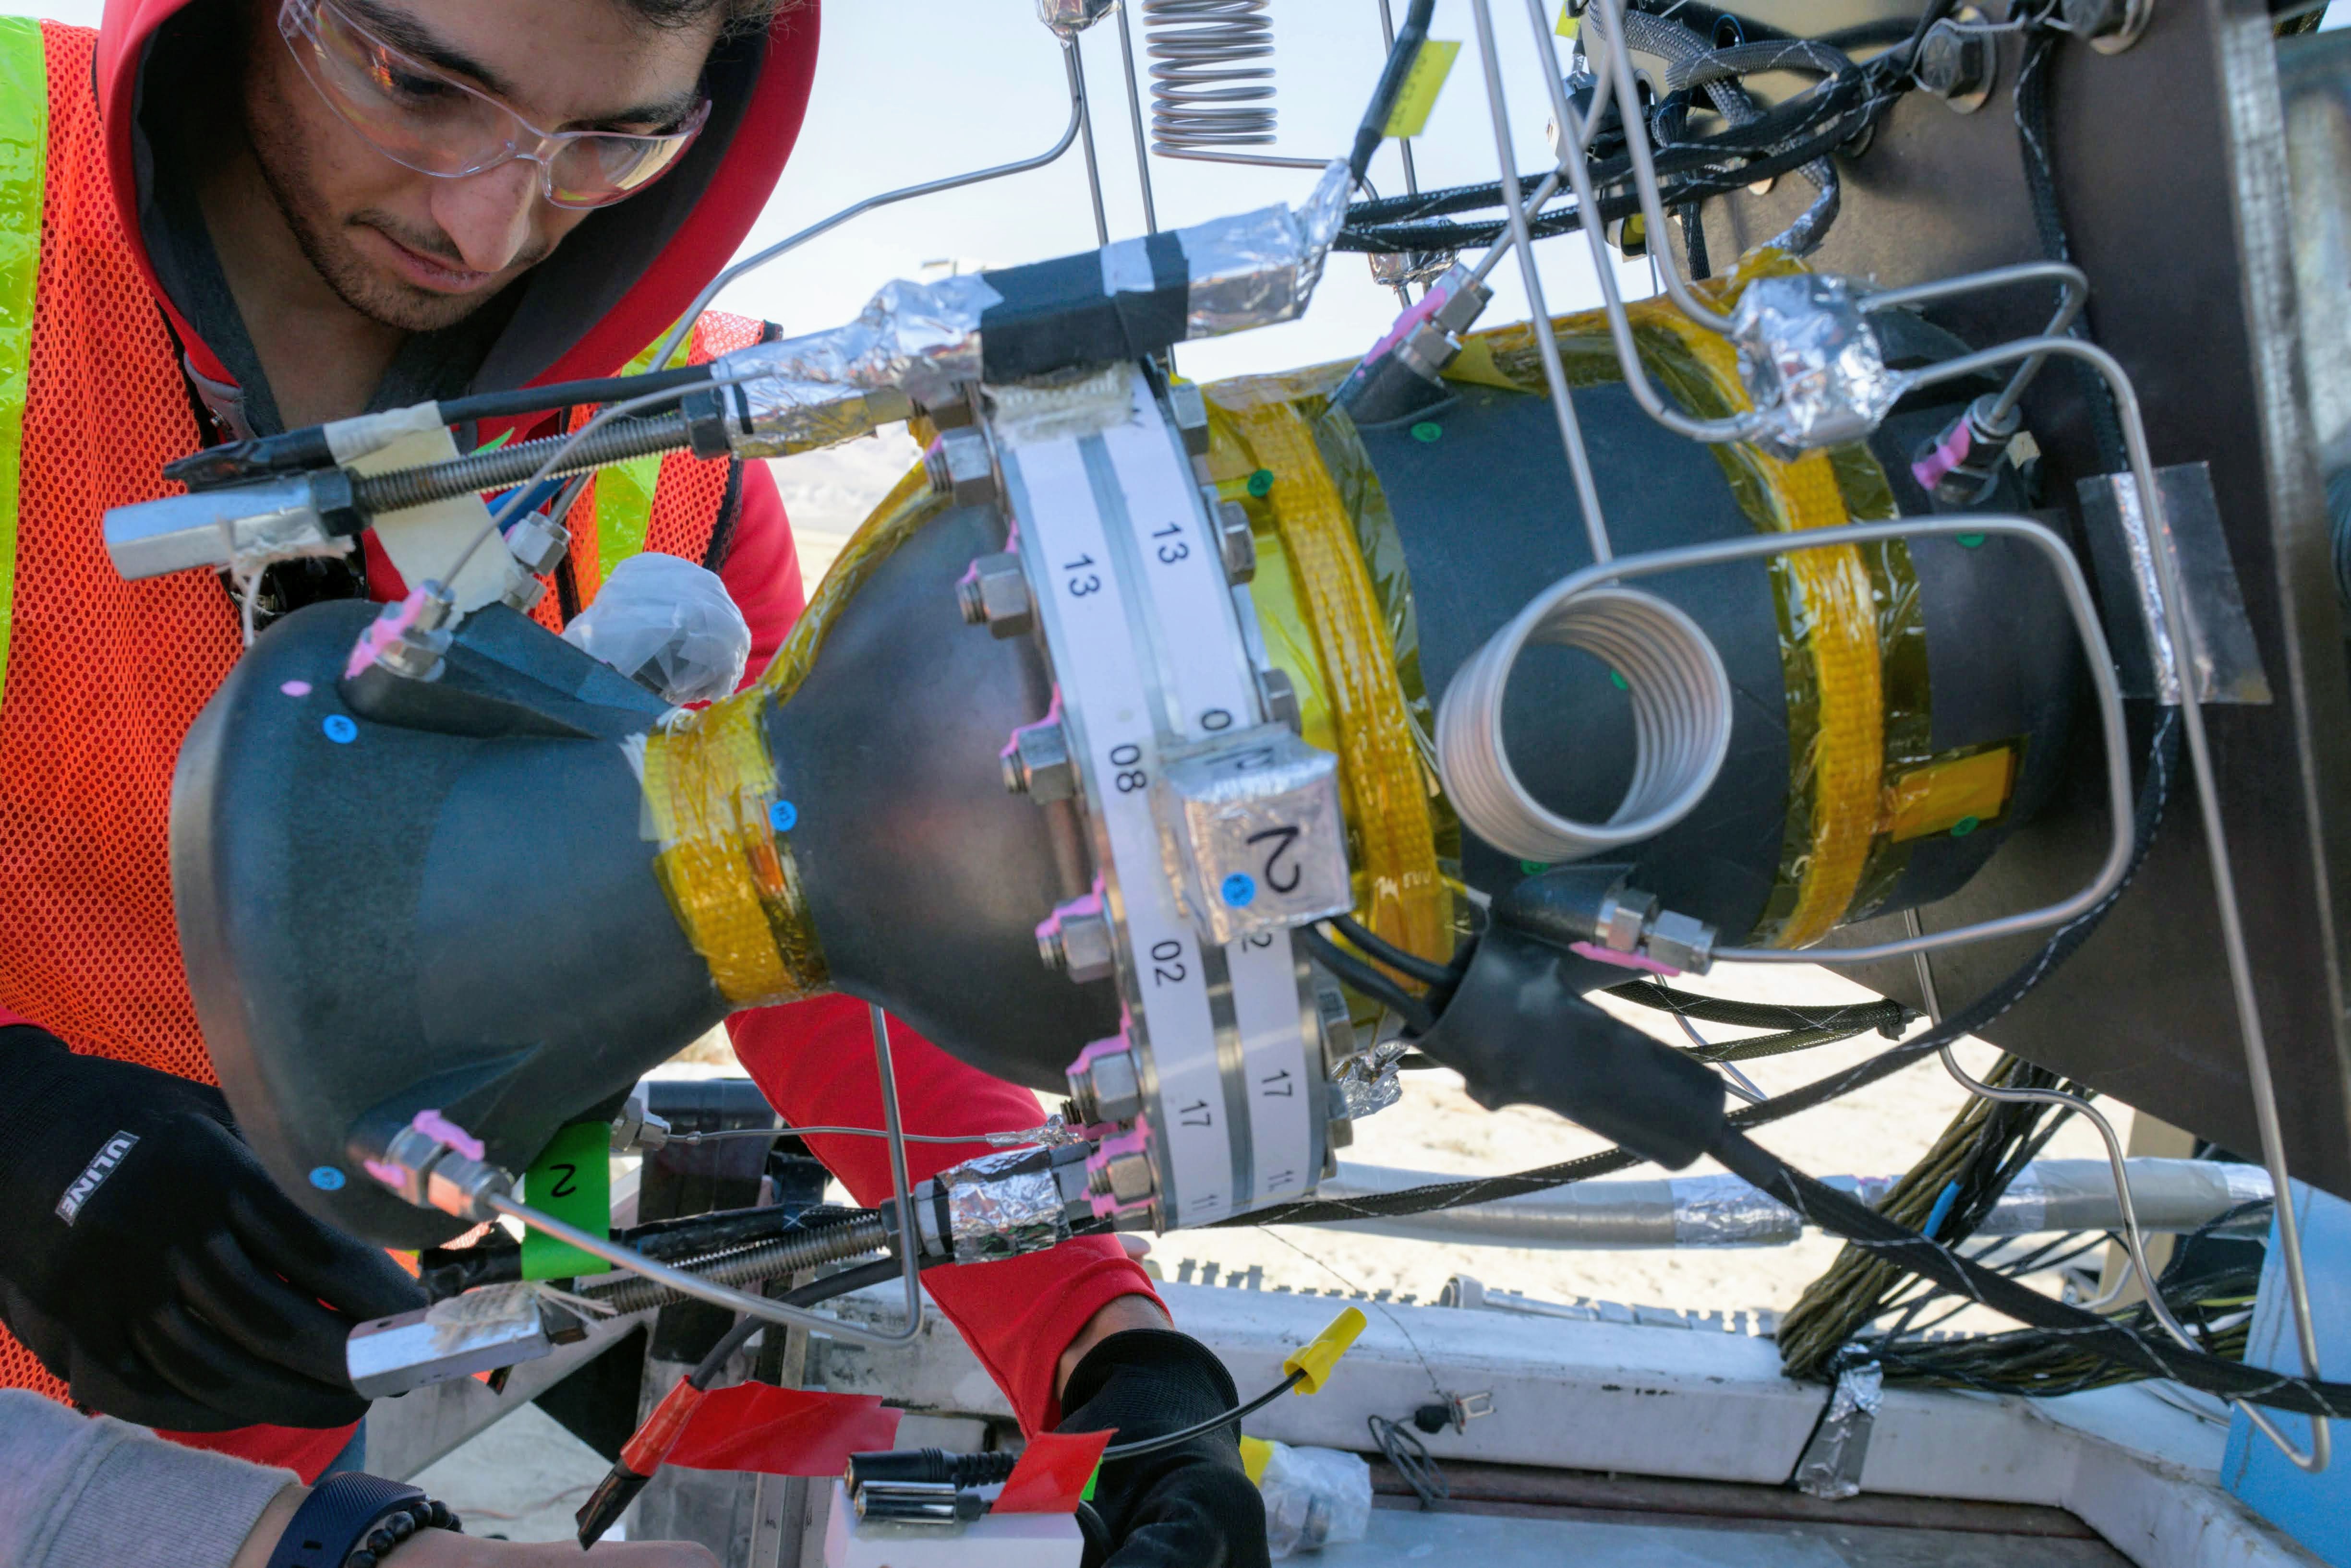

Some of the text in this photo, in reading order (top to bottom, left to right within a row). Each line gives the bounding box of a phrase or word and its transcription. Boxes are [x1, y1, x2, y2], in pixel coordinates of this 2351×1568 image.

[1151, 521, 1191, 565] 13
[1062, 552, 1102, 599] 13
[1108, 742, 1148, 795] 08
[1245, 826, 1301, 894] 2
[1149, 939, 1187, 988] 02
[1261, 1068, 1294, 1098] 17
[1178, 1099, 1212, 1127] 17
[61, 1139, 131, 1216] ULINE
